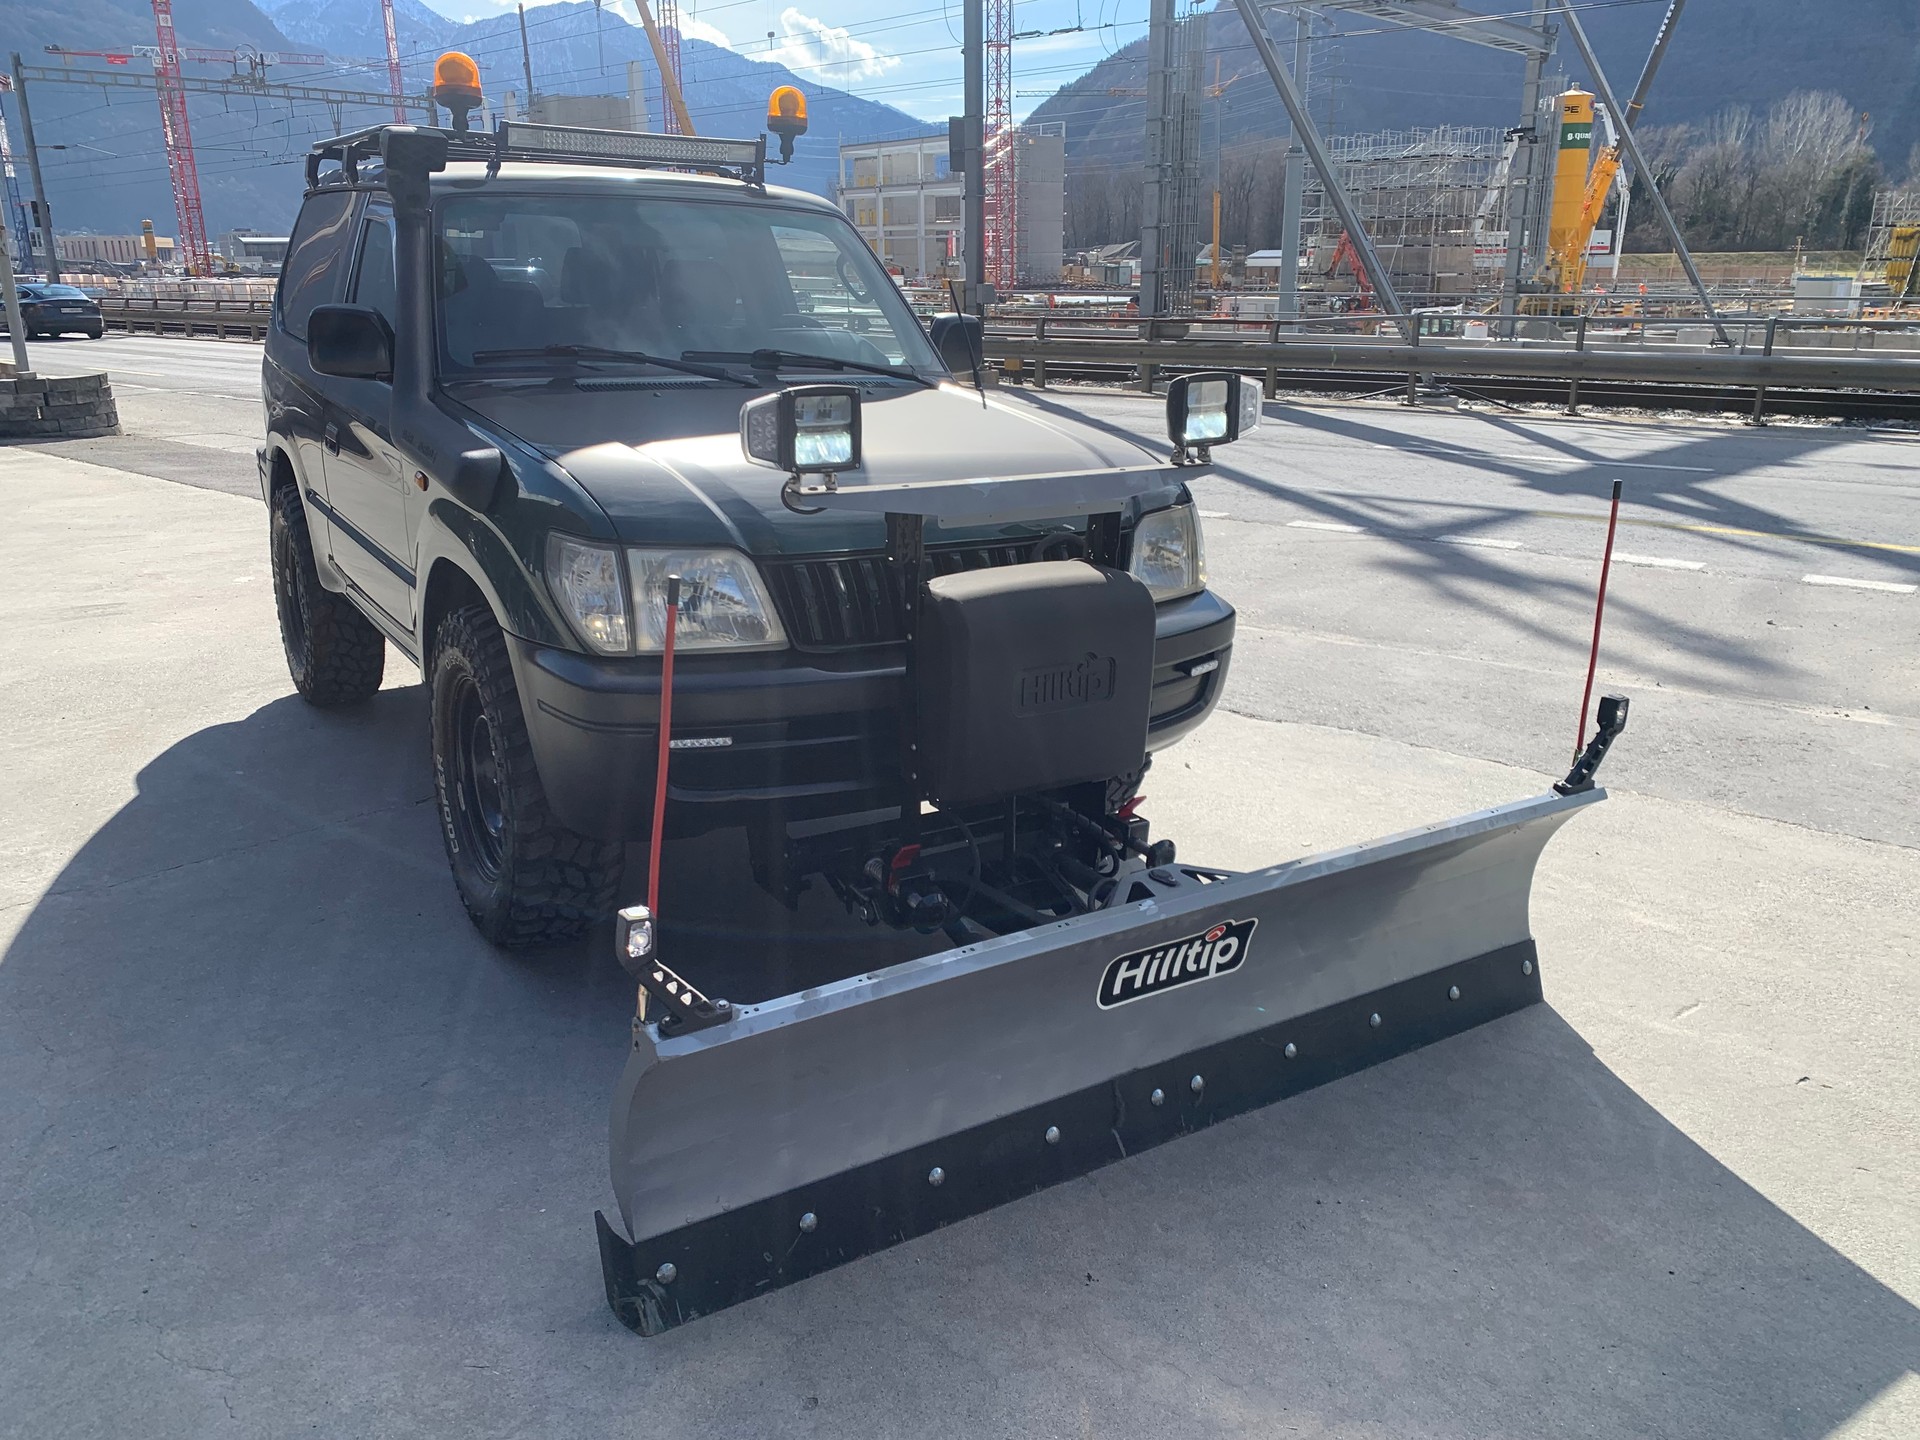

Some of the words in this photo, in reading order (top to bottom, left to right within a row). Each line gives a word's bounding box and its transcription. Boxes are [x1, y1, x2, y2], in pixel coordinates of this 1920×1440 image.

[167, 54, 174, 63] 5
[436, 753, 460, 854] COOPER
[1112, 928, 1240, 997] Hilltip
